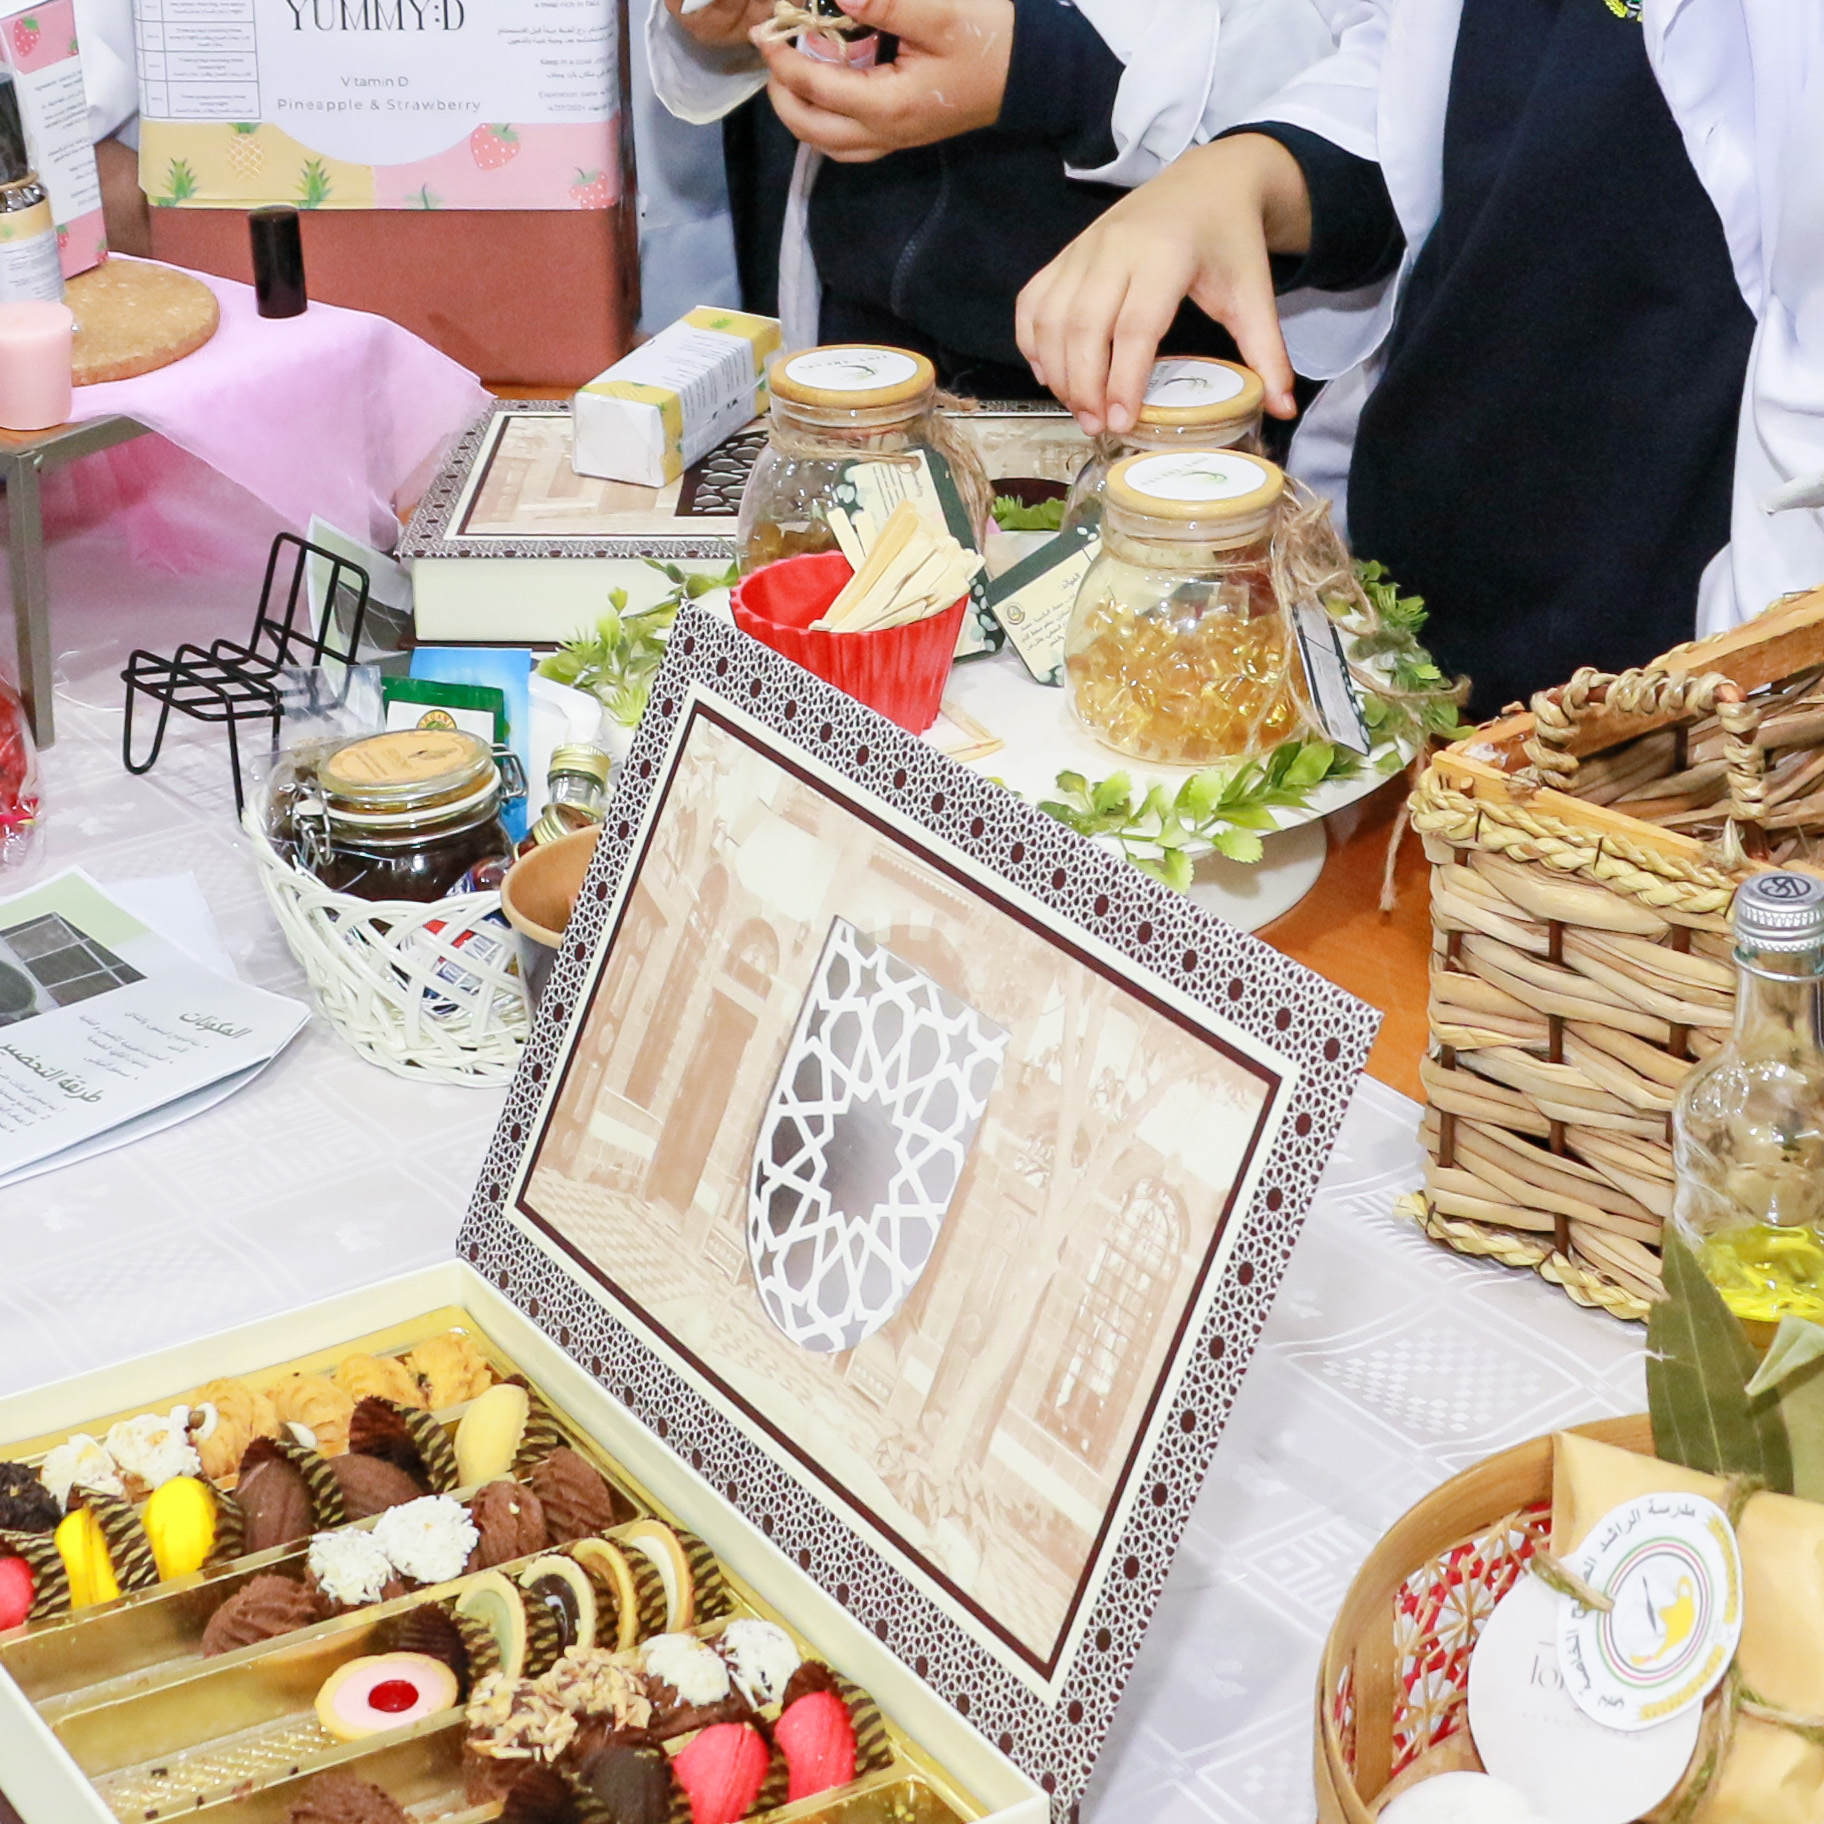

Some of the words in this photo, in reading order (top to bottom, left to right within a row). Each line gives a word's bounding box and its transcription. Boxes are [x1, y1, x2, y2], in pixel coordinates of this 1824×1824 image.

[340, 76, 394, 88] Vtamin
[398, 76, 410, 88] D
[276, 98, 364, 114] Pineapple
[369, 99, 381, 112] &
[385, 98, 482, 114] Strawberry
[178, 1012, 253, 1039] المكونات
[57, 1074, 103, 1103] طريقة
[1647, 1498, 1696, 1518] مدرسة
[1600, 1508, 1642, 1553] الراشد
